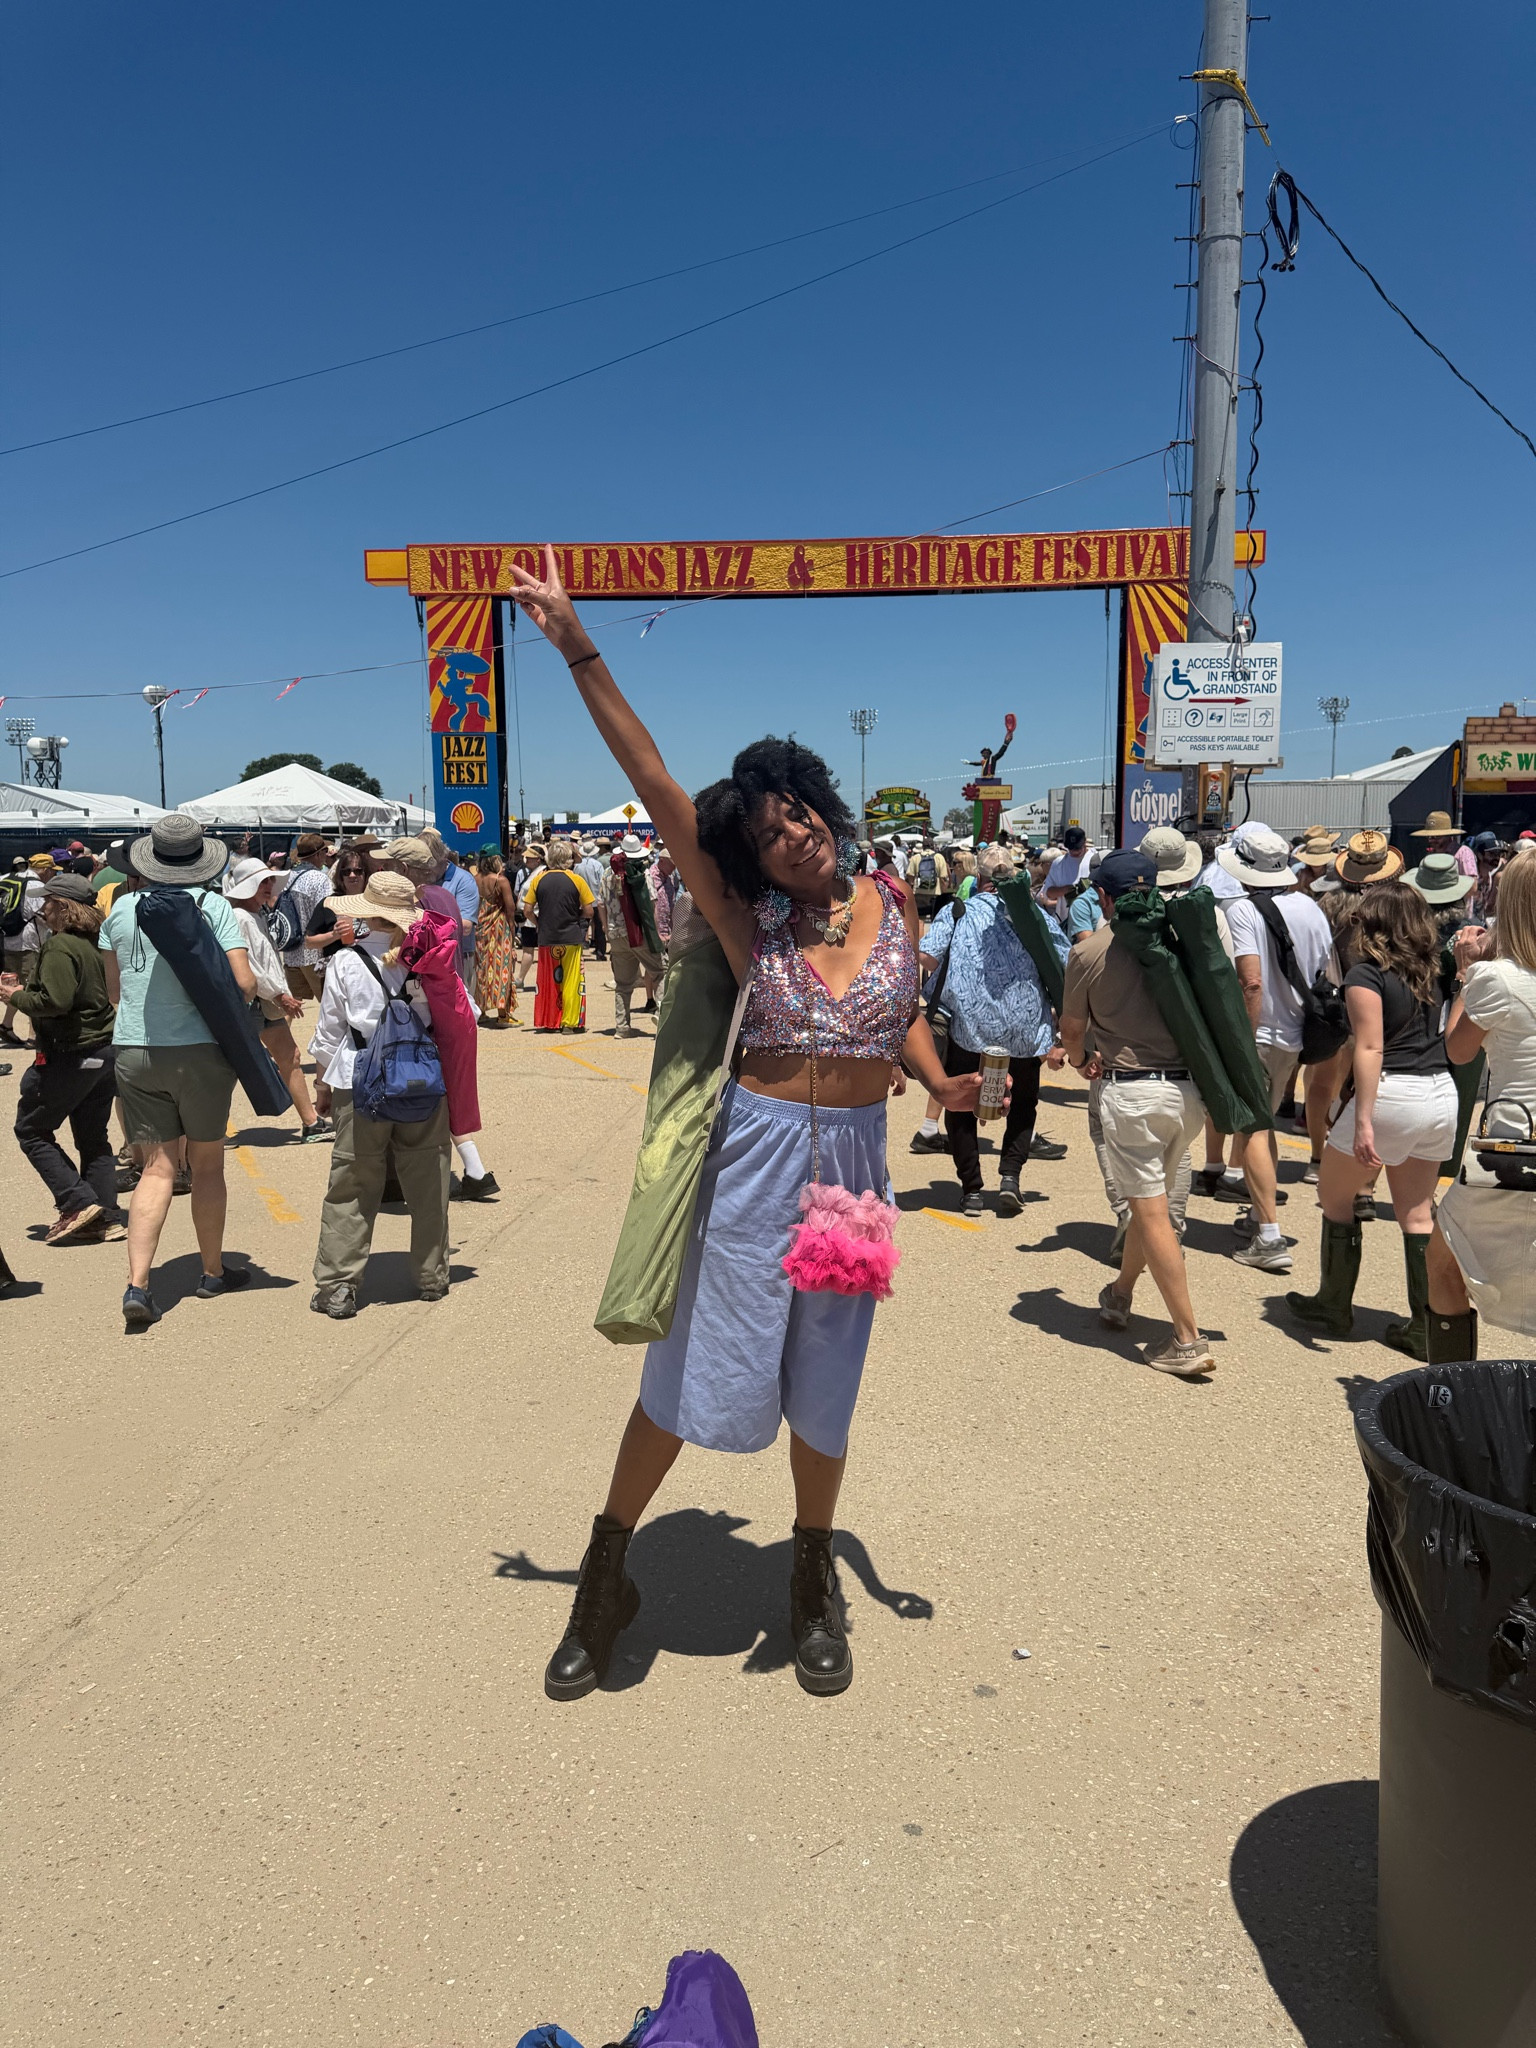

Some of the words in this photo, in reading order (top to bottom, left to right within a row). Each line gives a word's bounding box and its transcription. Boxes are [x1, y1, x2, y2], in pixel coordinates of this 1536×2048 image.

[429, 548, 502, 590] NEW
[677, 546, 755, 591] JAZZ
[787, 544, 815, 588] &
[846, 539, 1021, 588] HERITAGE
[1187, 658, 1230, 669] ACCESS
[1234, 657, 1278, 669] CENTER
[1207, 671, 1218, 682] IN
[1221, 670, 1258, 682] FRONT
[1261, 670, 1278, 681] OF
[1202, 683, 1277, 695] GRANDSTAND
[1177, 735, 1216, 743] ACCESSIBLE
[1217, 735, 1251, 743] PORTABLE
[1252, 735, 1274, 743] TOILET
[444, 736, 485, 760] JAZZ
[1516, 753, 1536, 771] W
[445, 762, 486, 783] FEST
[1142, 779, 1154, 793] The
[1130, 787, 1182, 826] Gospel
[1176, 1349, 1197, 1358] HOKA
